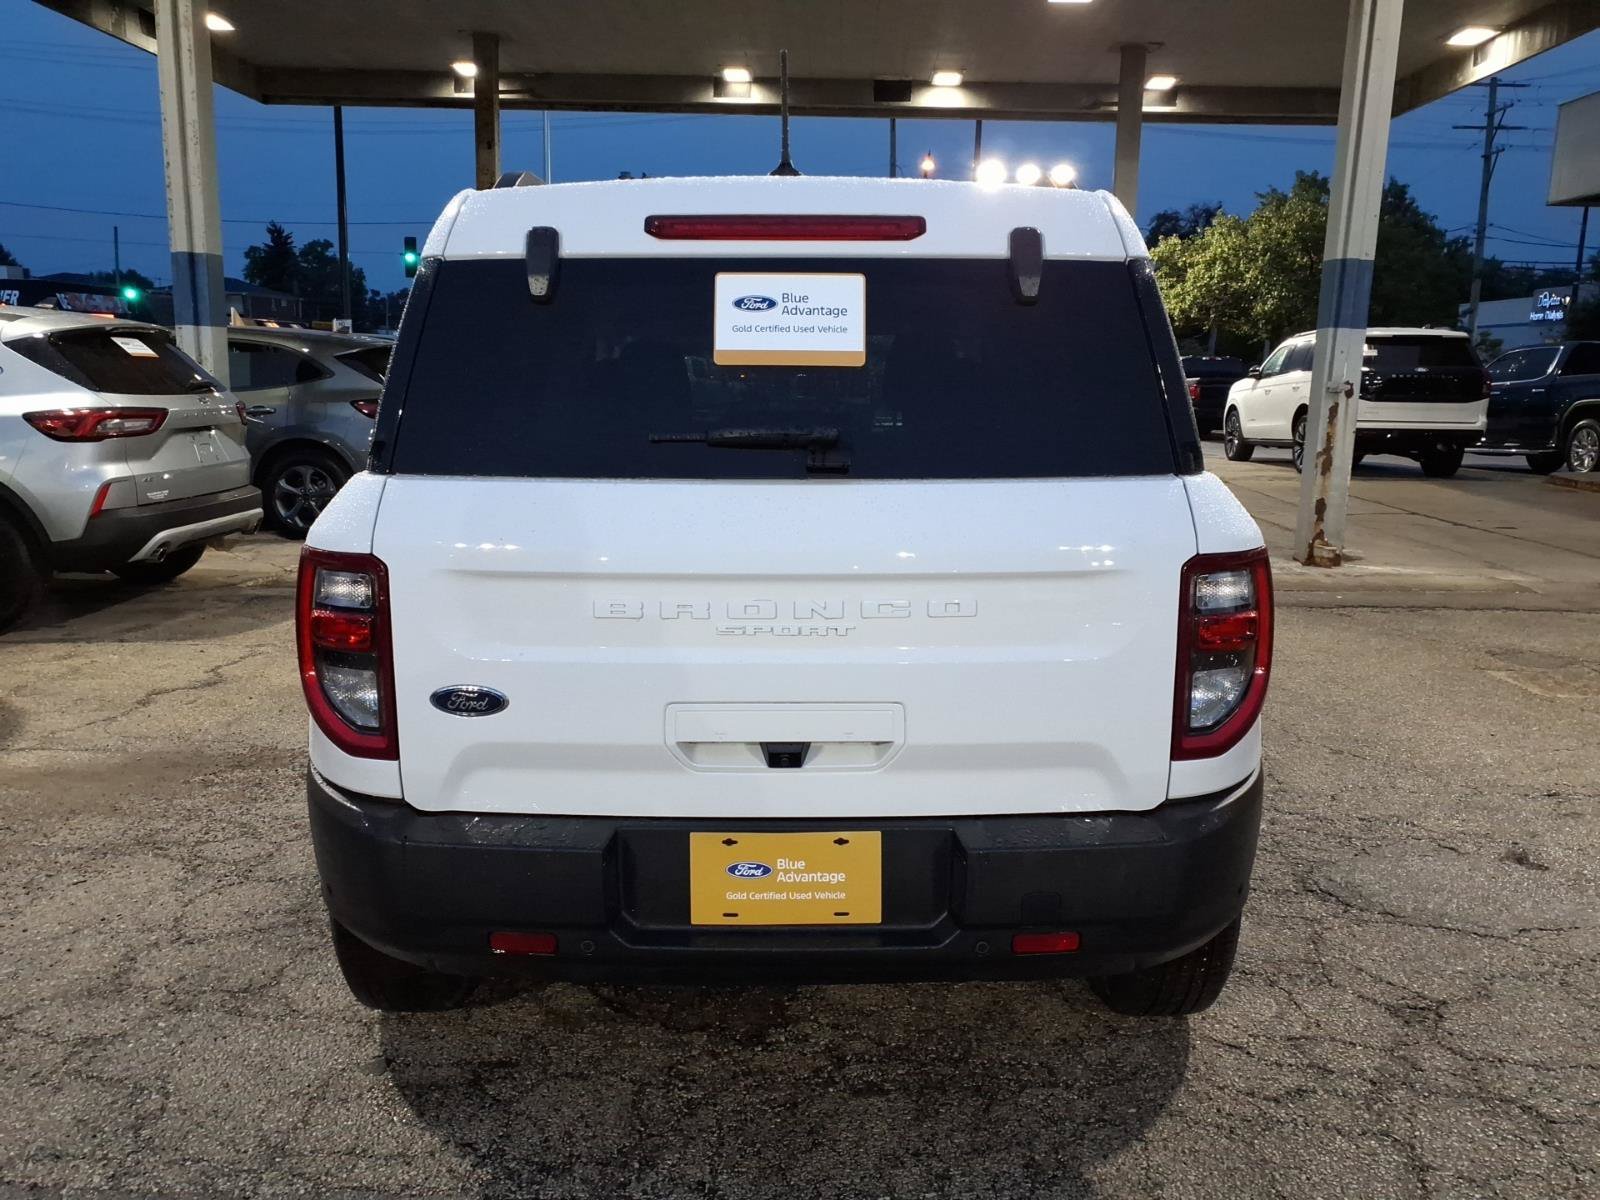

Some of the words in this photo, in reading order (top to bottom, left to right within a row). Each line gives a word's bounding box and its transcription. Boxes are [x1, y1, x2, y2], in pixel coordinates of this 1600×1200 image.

[781, 292, 810, 304] Blue
[781, 305, 849, 318] Advantage
[732, 324, 753, 333] Gold
[755, 324, 791, 333] Certified
[793, 325, 815, 333] Used
[818, 325, 848, 333] Vehicle
[593, 599, 978, 620] BRONCO
[716, 625, 856, 636] SPORT
[776, 858, 806, 870] Blue
[776, 871, 846, 885] Advantage
[726, 891, 747, 900] Gold
[749, 891, 787, 900] Certified
[789, 891, 812, 900] Used
[814, 891, 846, 900] Vehicle
